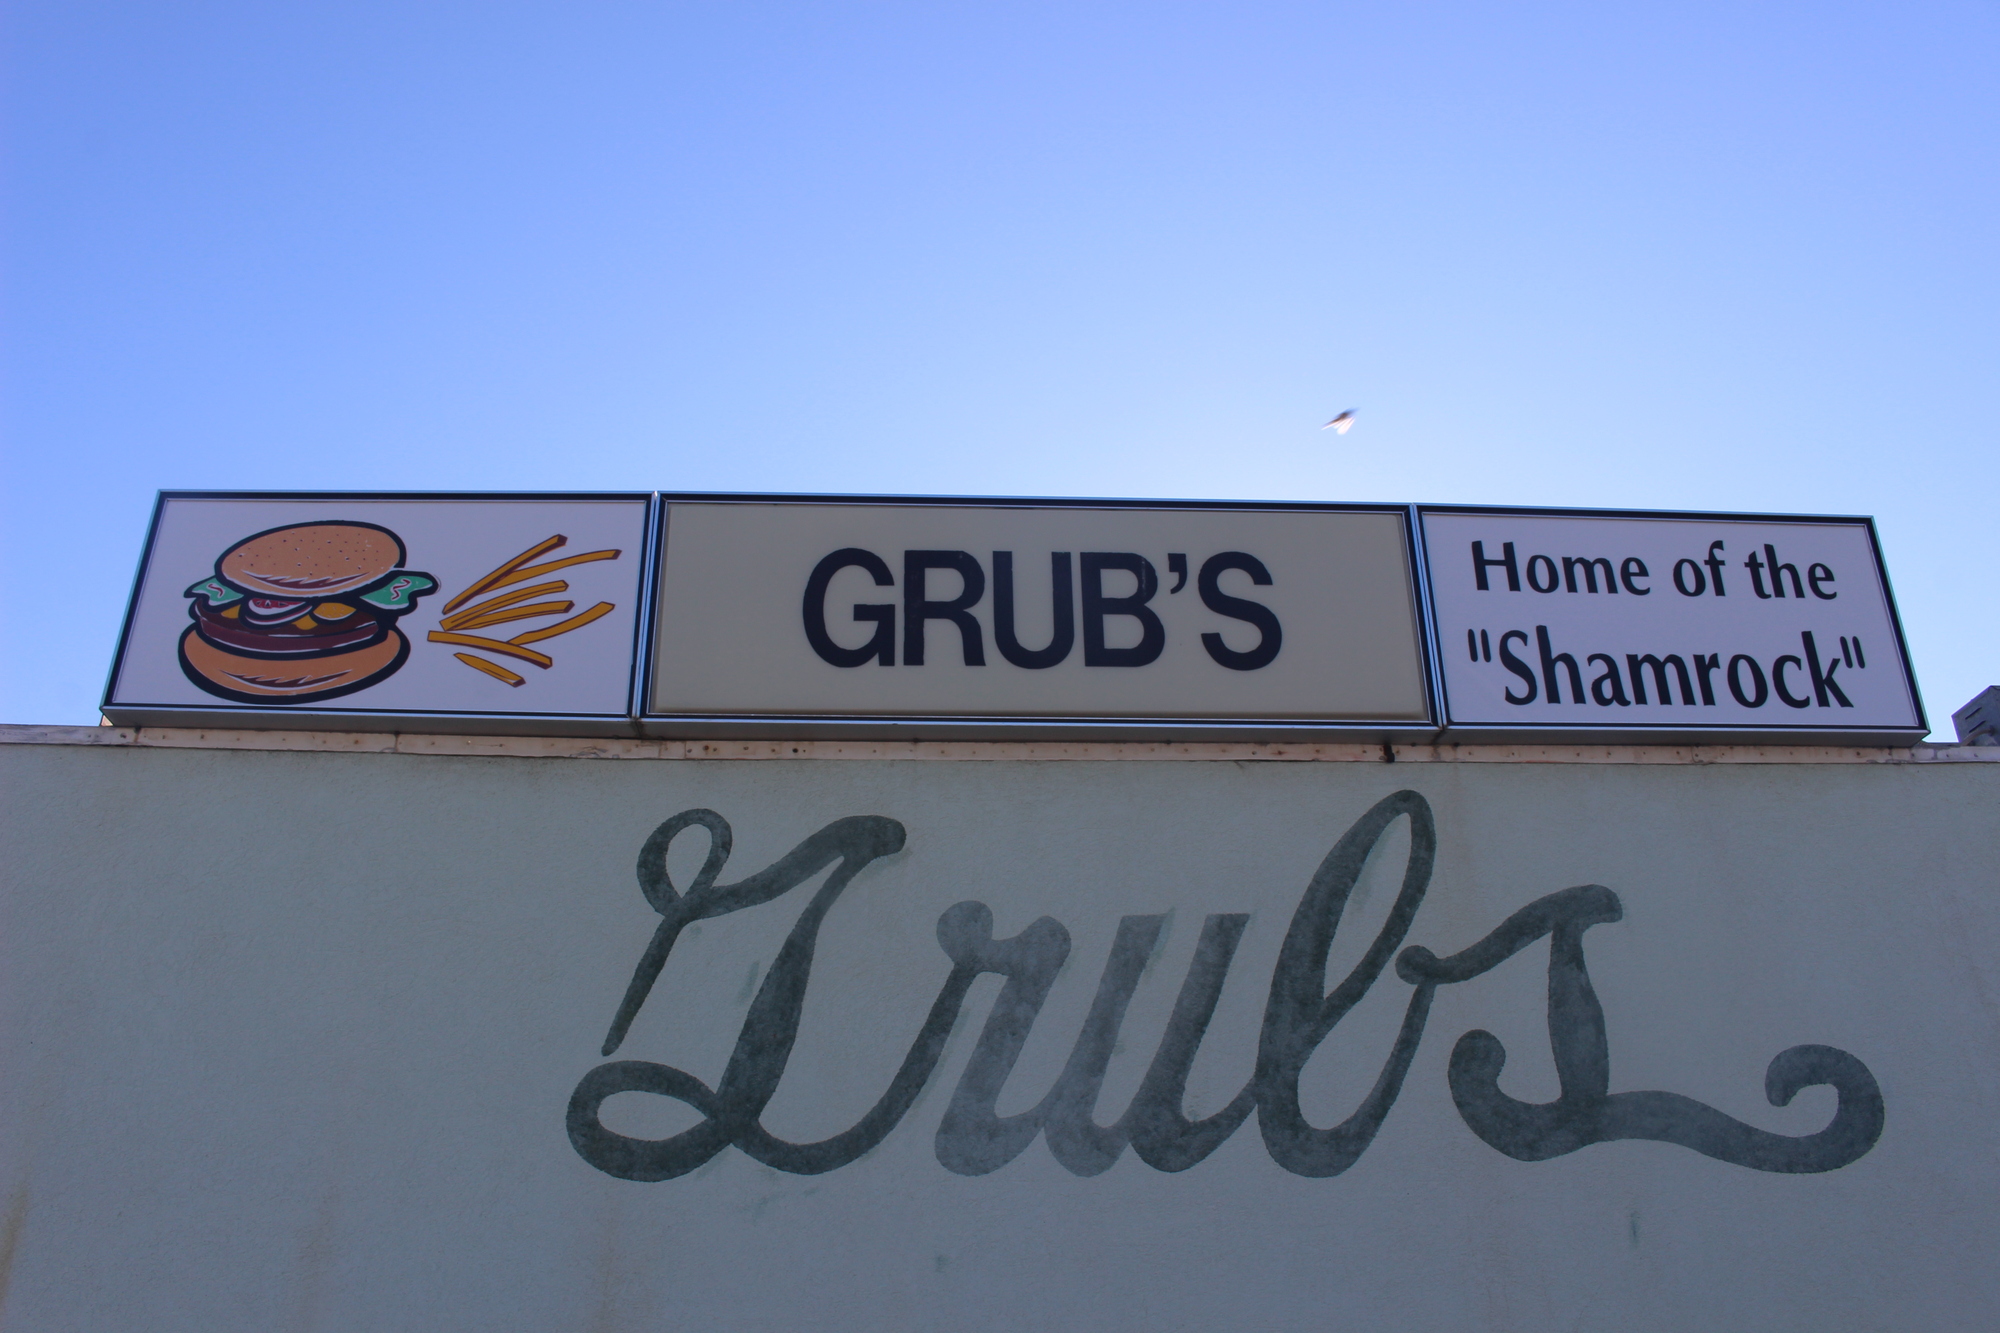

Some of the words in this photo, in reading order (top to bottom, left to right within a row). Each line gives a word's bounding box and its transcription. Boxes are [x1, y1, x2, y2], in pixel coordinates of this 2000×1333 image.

[801, 547, 1283, 672] GRUB'S
[1470, 540, 1651, 596] Home
[1672, 539, 1726, 598] of
[1743, 543, 1838, 601] the
[1467, 624, 1867, 709] "Shamrock"
[566, 789, 1885, 1183] Grubs
